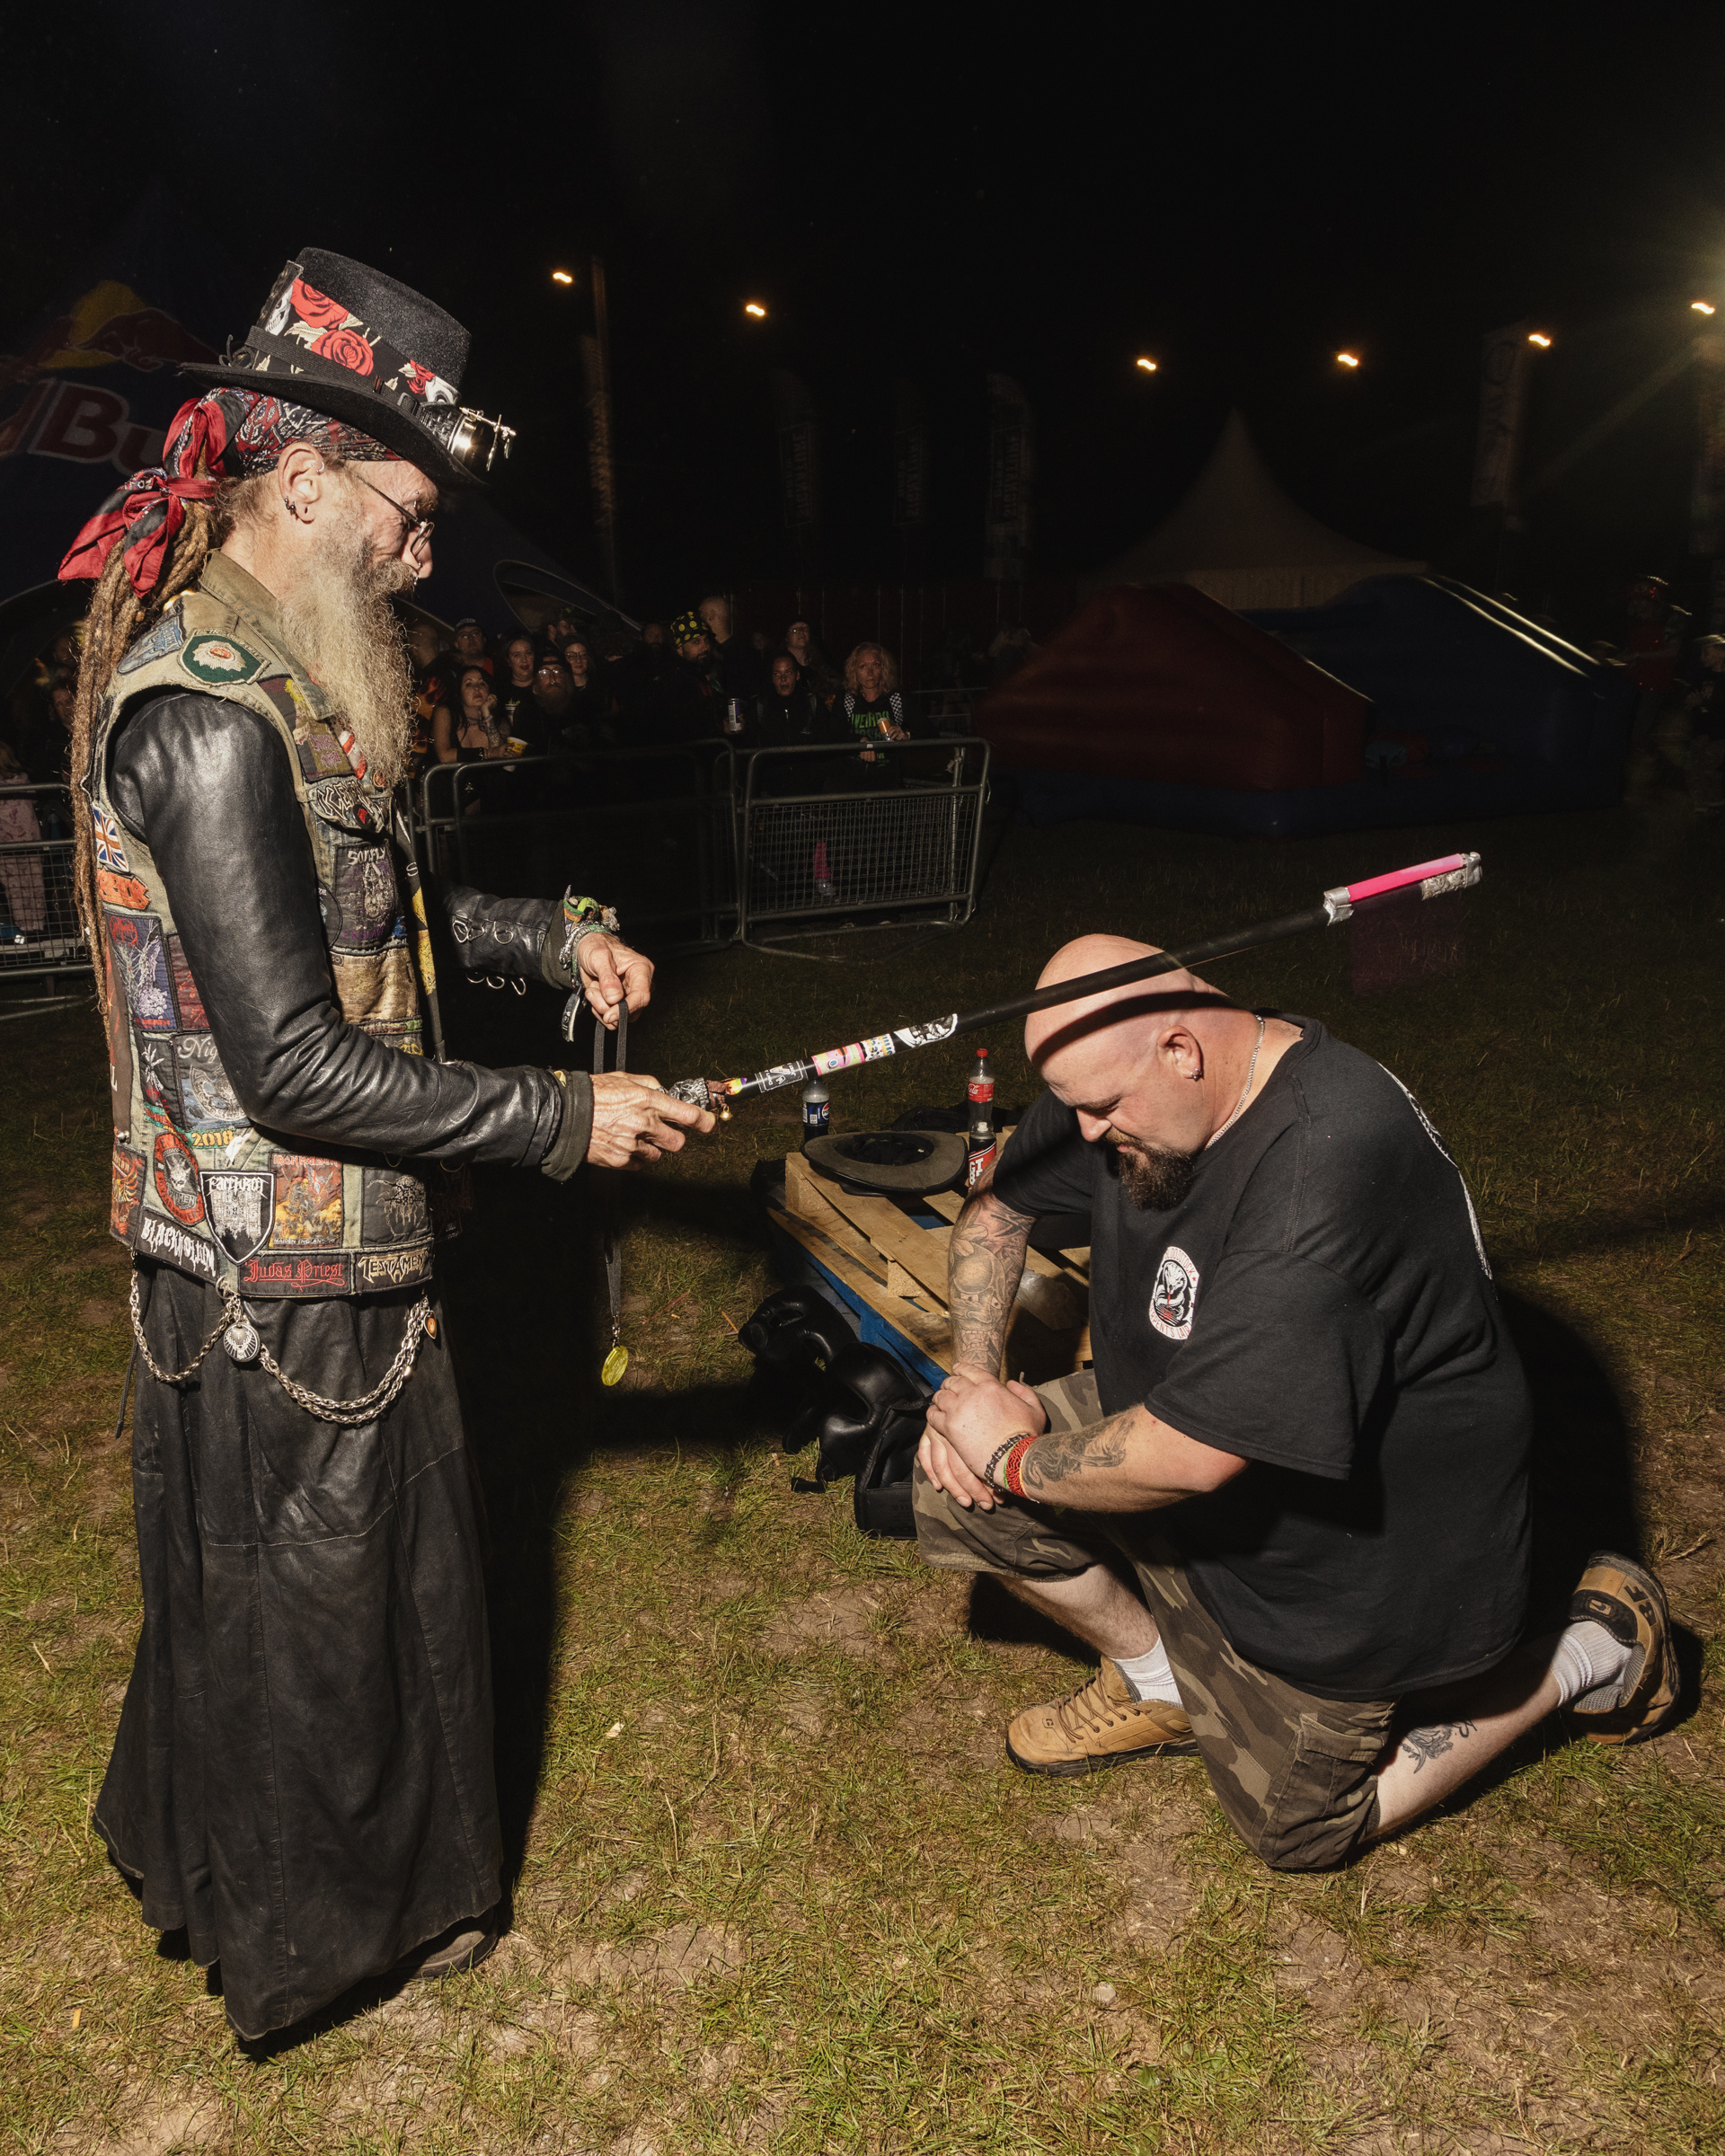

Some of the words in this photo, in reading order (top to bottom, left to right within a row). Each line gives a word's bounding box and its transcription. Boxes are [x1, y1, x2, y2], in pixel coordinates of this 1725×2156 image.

[31, 380, 165, 473] Bu
[191, 1130, 234, 1146] 2018
[273, 1154, 298, 1168] IRON
[969, 1157, 984, 1172] GT
[243, 1259, 293, 1283] Judas
[294, 1259, 343, 1285] Priest
